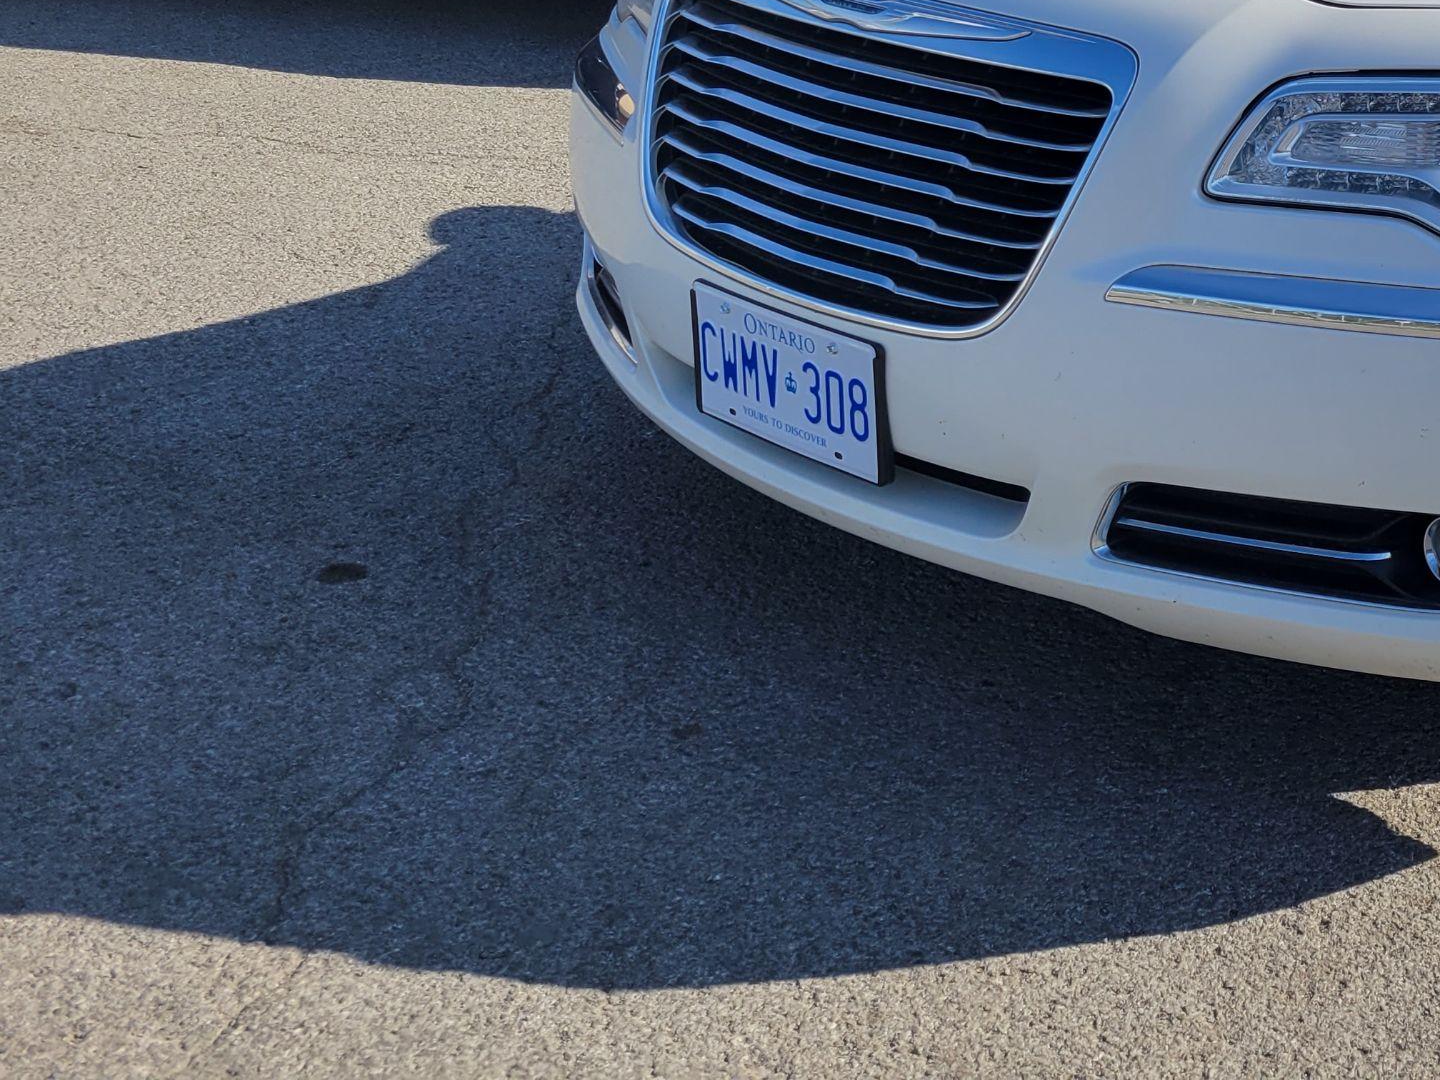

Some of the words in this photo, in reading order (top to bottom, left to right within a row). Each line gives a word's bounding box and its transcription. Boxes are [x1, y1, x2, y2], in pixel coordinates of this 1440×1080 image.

[744, 313, 815, 354] ONTARIO
[701, 321, 778, 409] CWMV
[802, 361, 870, 443] 308
[743, 405, 769, 425] YOURS
[770, 417, 783, 430] TO
[785, 423, 828, 448] DISCOVER
